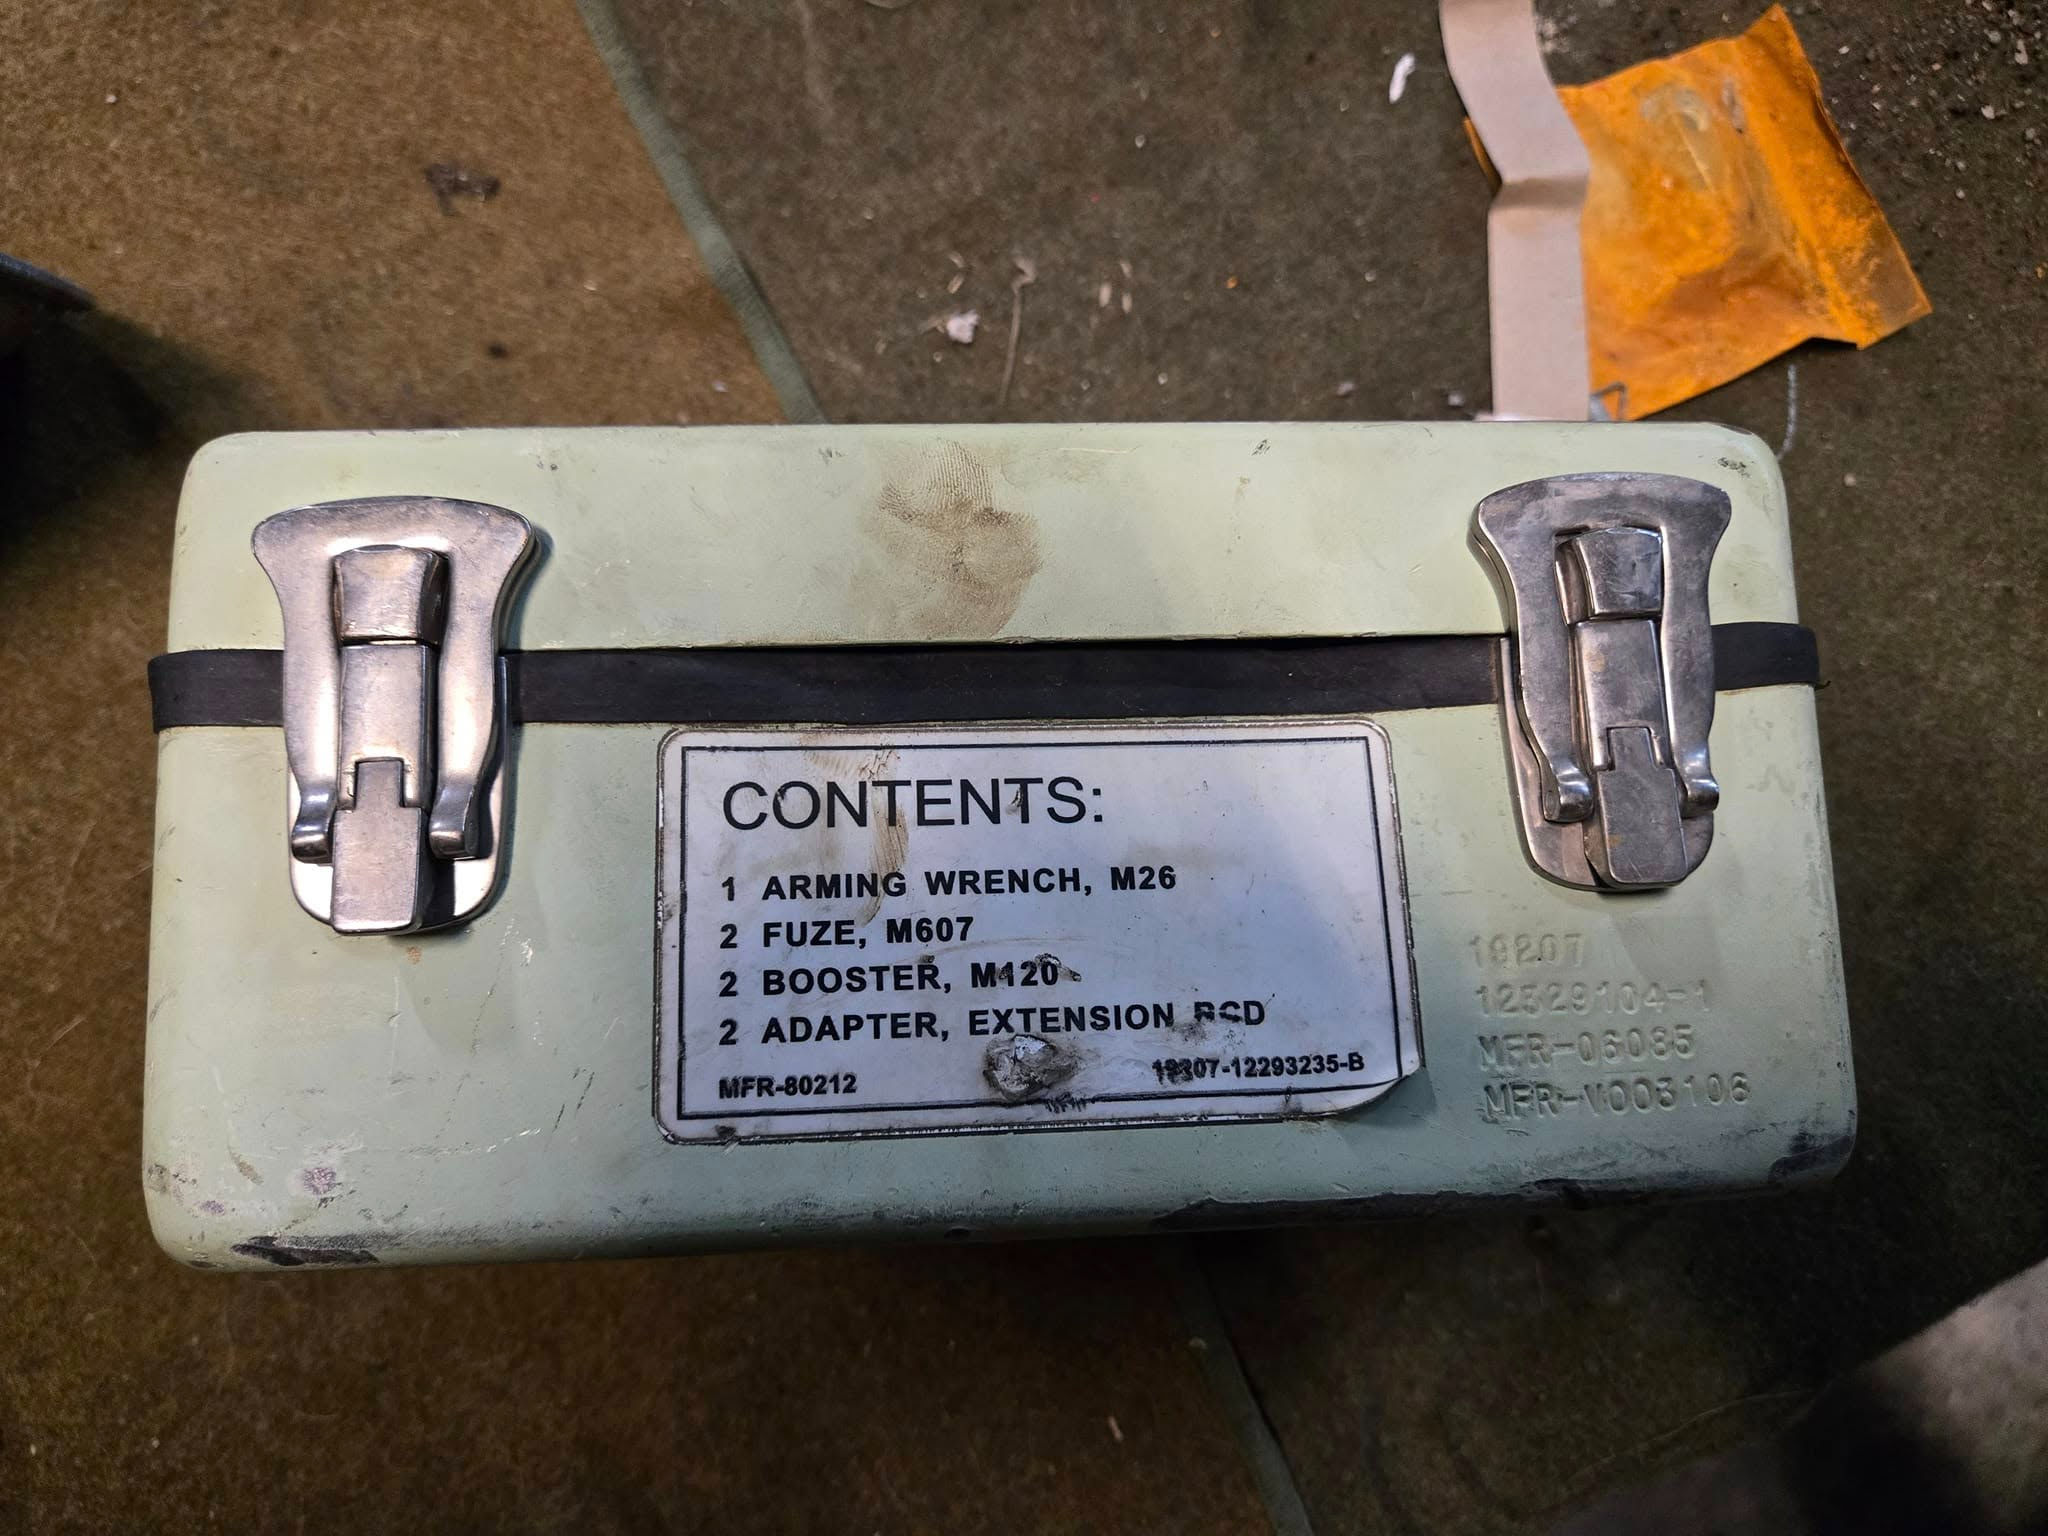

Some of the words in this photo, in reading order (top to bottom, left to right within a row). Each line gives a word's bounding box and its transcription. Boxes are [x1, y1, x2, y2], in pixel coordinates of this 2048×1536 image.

[723, 776, 1102, 830] CONTENTS:
[721, 876, 735, 901] 1
[762, 871, 907, 900] ARMING
[925, 867, 1092, 897] WRENCH,
[1110, 865, 1176, 891] M26
[720, 923, 738, 949] 2
[763, 919, 866, 950] FUZE,
[886, 916, 974, 943] M607
[719, 970, 738, 997] 2
[763, 964, 951, 996] BOOSTER,
[971, 961, 1058, 988] M120
[719, 1018, 738, 1045] 2
[761, 1011, 949, 1043] ADAPTER,
[969, 1001, 1174, 1036] EXTENSION
[1478, 1023, 1696, 1071] MFR-06085
[719, 1073, 857, 1099] MFR-80212
